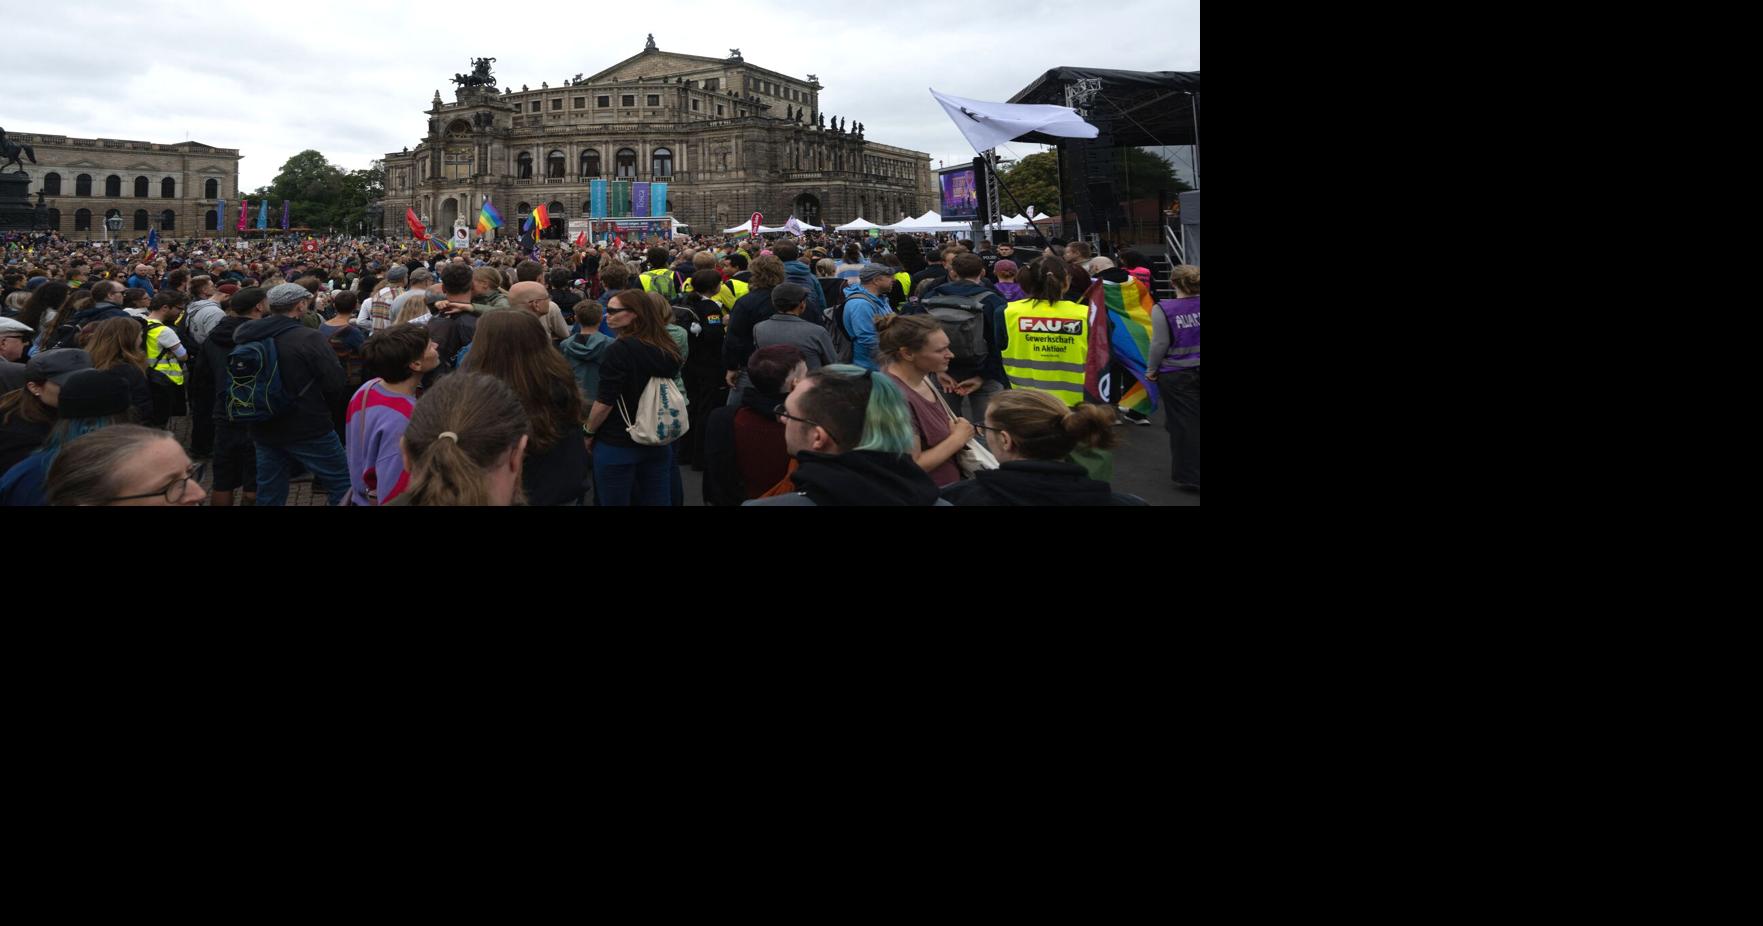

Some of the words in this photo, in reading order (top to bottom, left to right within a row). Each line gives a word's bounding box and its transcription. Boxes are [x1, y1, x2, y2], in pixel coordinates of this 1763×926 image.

[636, 190, 645, 210] Tosca
[1020, 318, 1062, 332] FAU
[1025, 334, 1074, 344] Gewerkschaft
[1033, 344, 1040, 352] in
[1042, 345, 1067, 353] Aktion!
